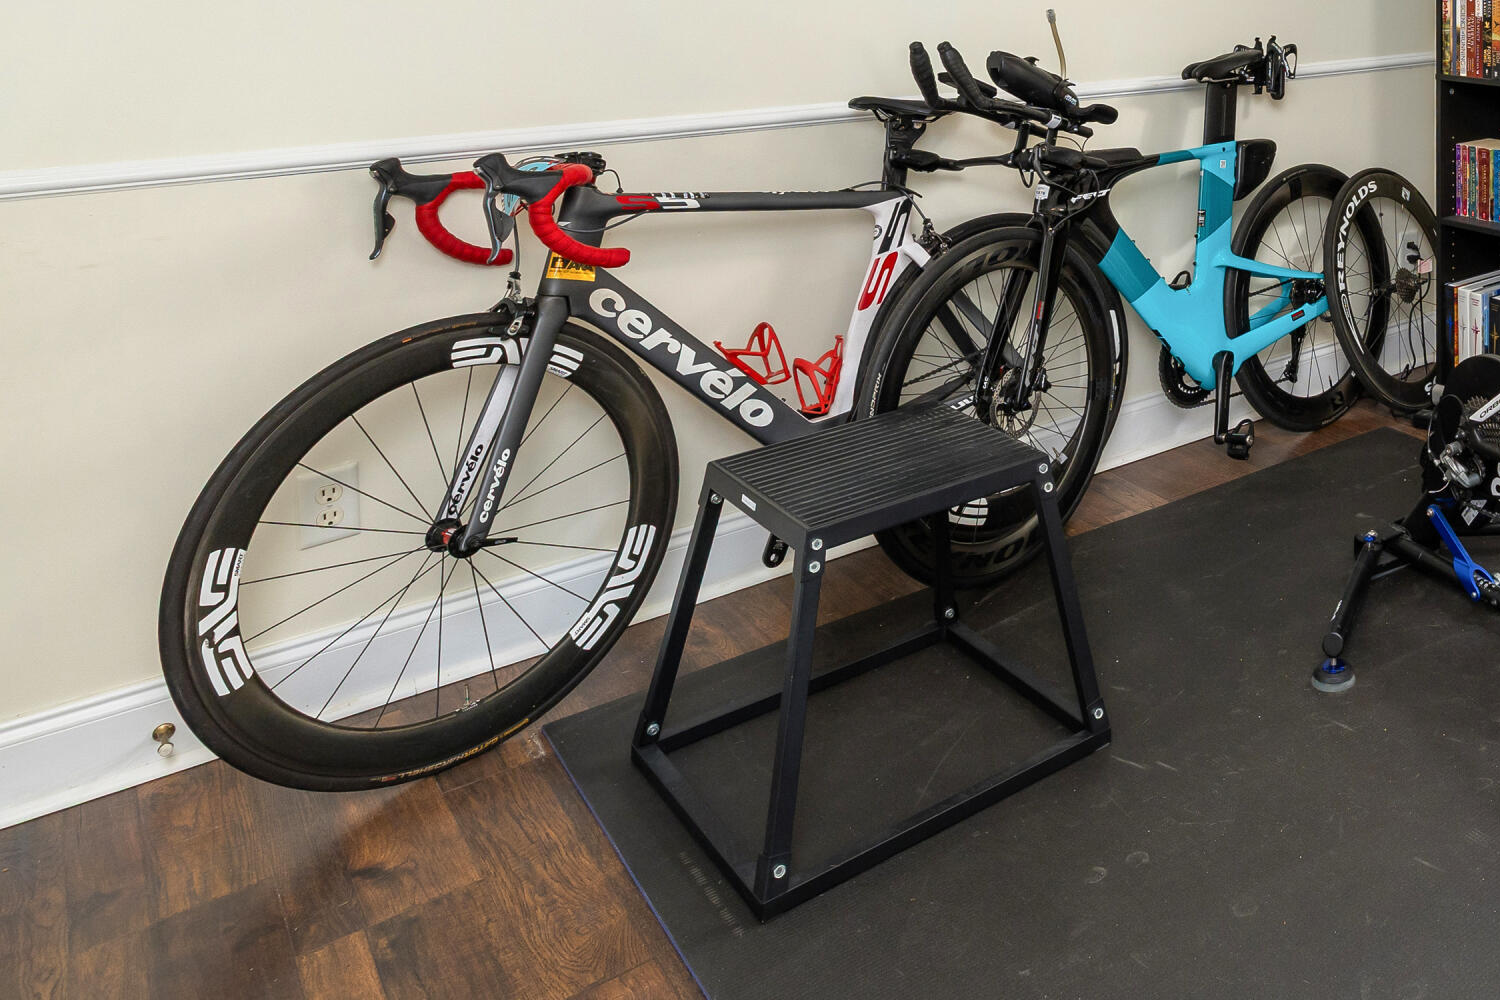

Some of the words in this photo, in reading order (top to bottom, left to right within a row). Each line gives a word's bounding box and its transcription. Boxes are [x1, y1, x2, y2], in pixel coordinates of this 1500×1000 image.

[1335, 179, 1378, 293] REYNOLDS
[588, 287, 775, 428] cervélo
[448, 443, 484, 516] cervélo
[479, 448, 511, 524] cervélo
